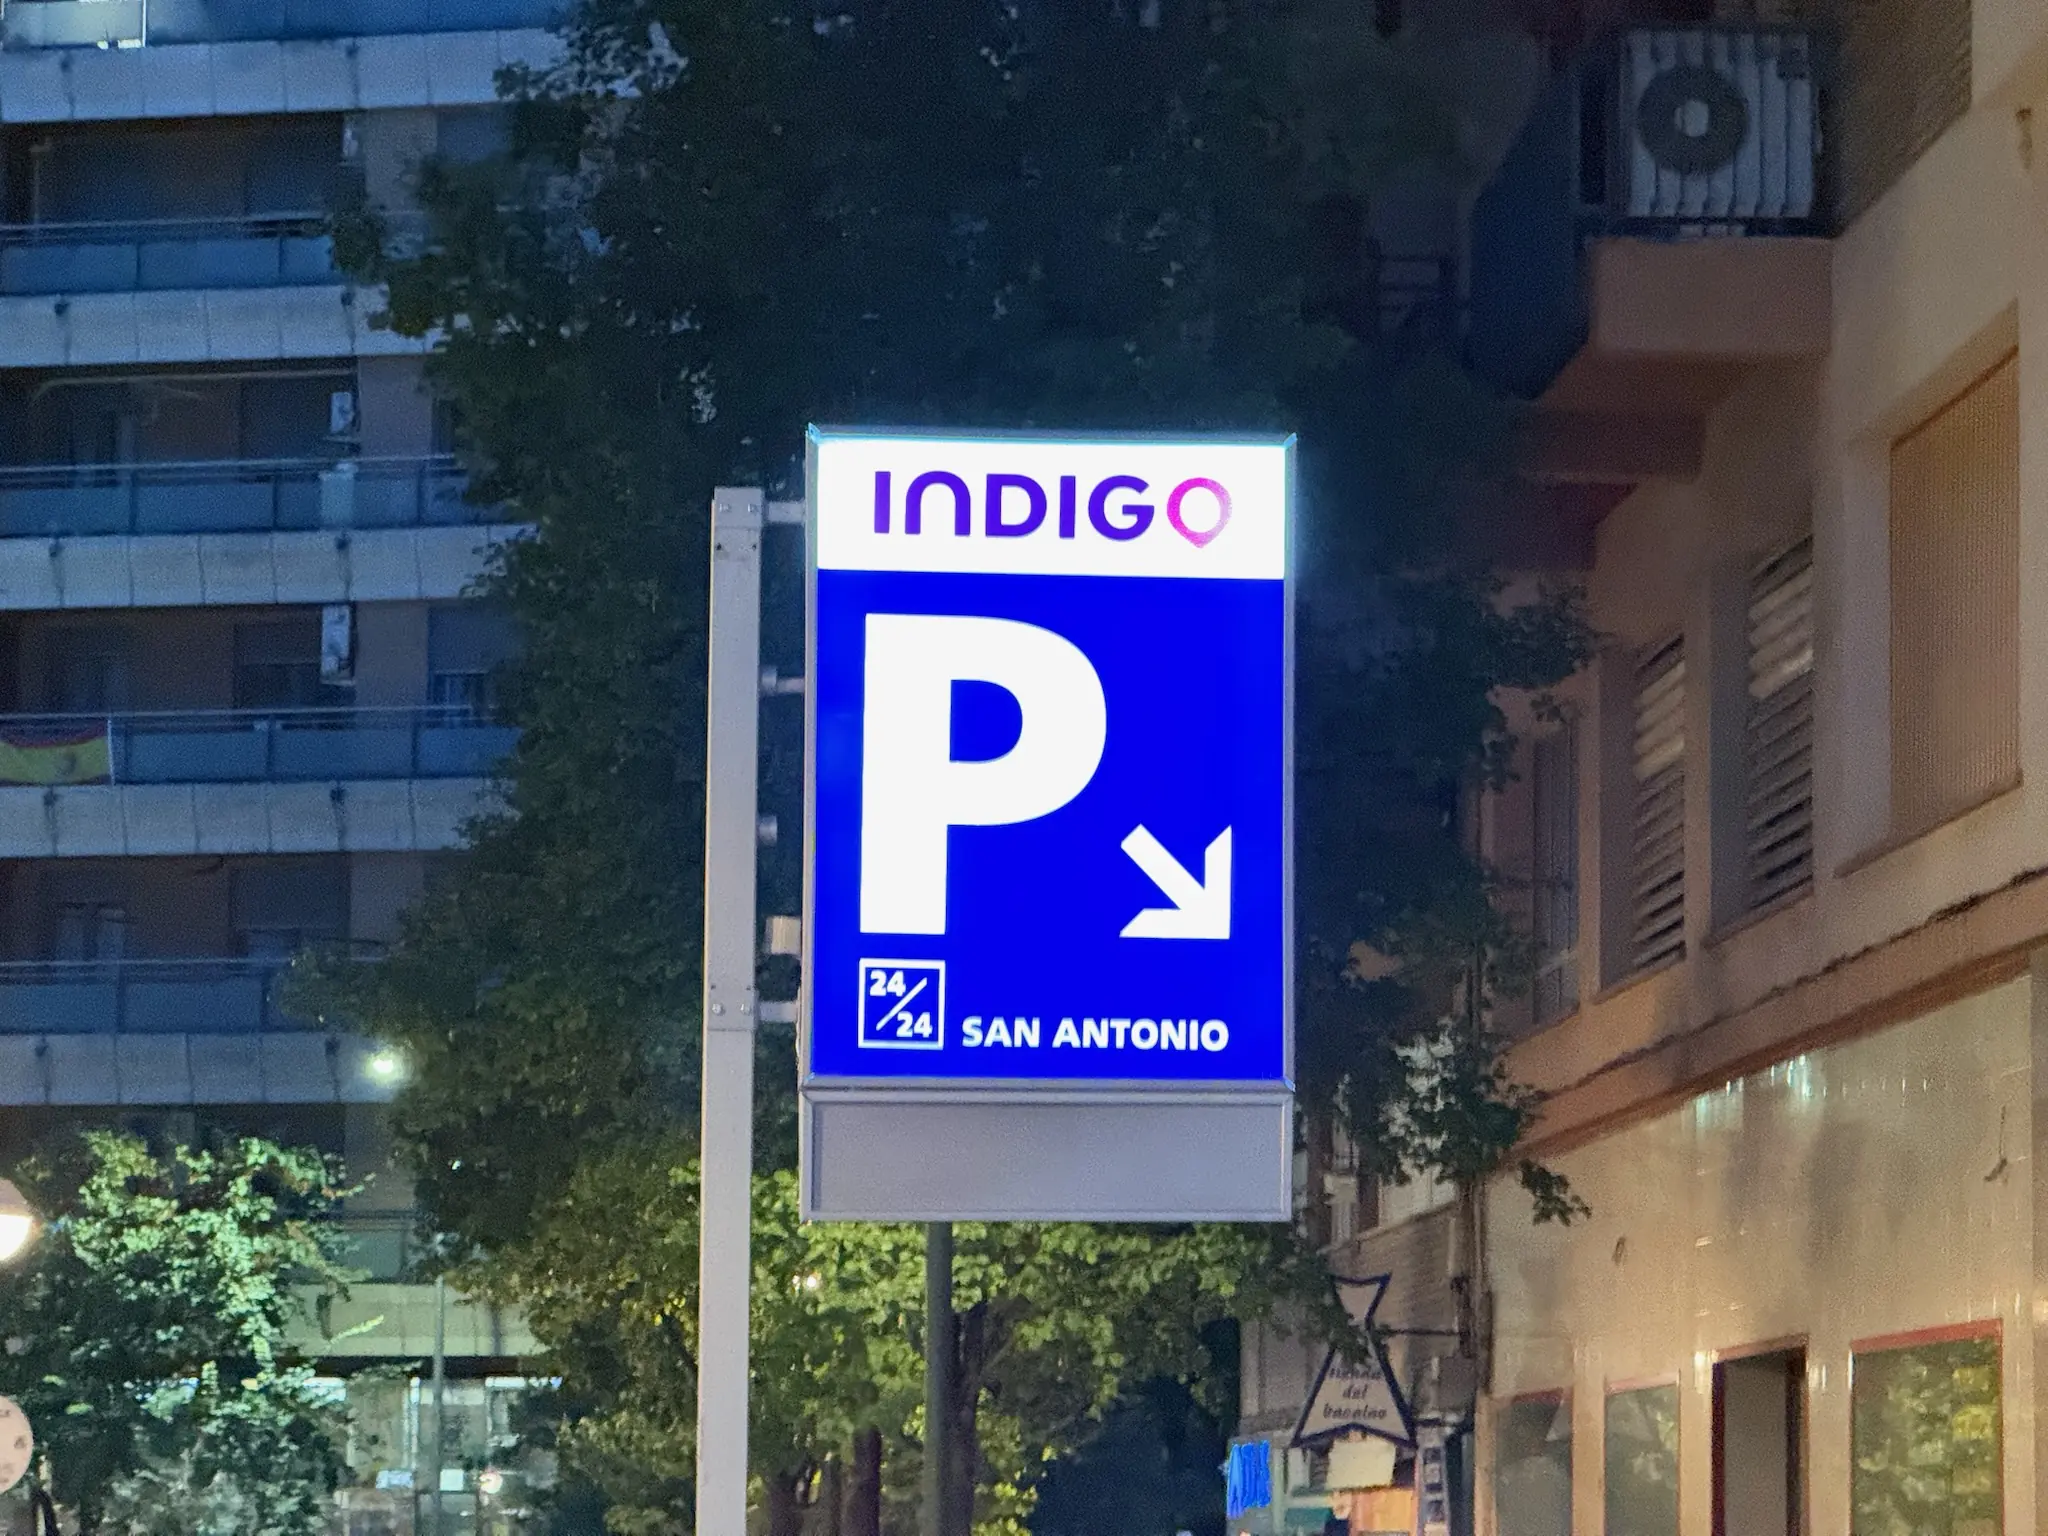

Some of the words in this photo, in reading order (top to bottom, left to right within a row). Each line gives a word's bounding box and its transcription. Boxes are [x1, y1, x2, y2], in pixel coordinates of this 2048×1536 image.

[873, 470, 1231, 548] INDIGO
[860, 613, 1106, 935] P
[961, 1015, 1041, 1048] SAN
[1051, 1017, 1230, 1052] ANTONIO
